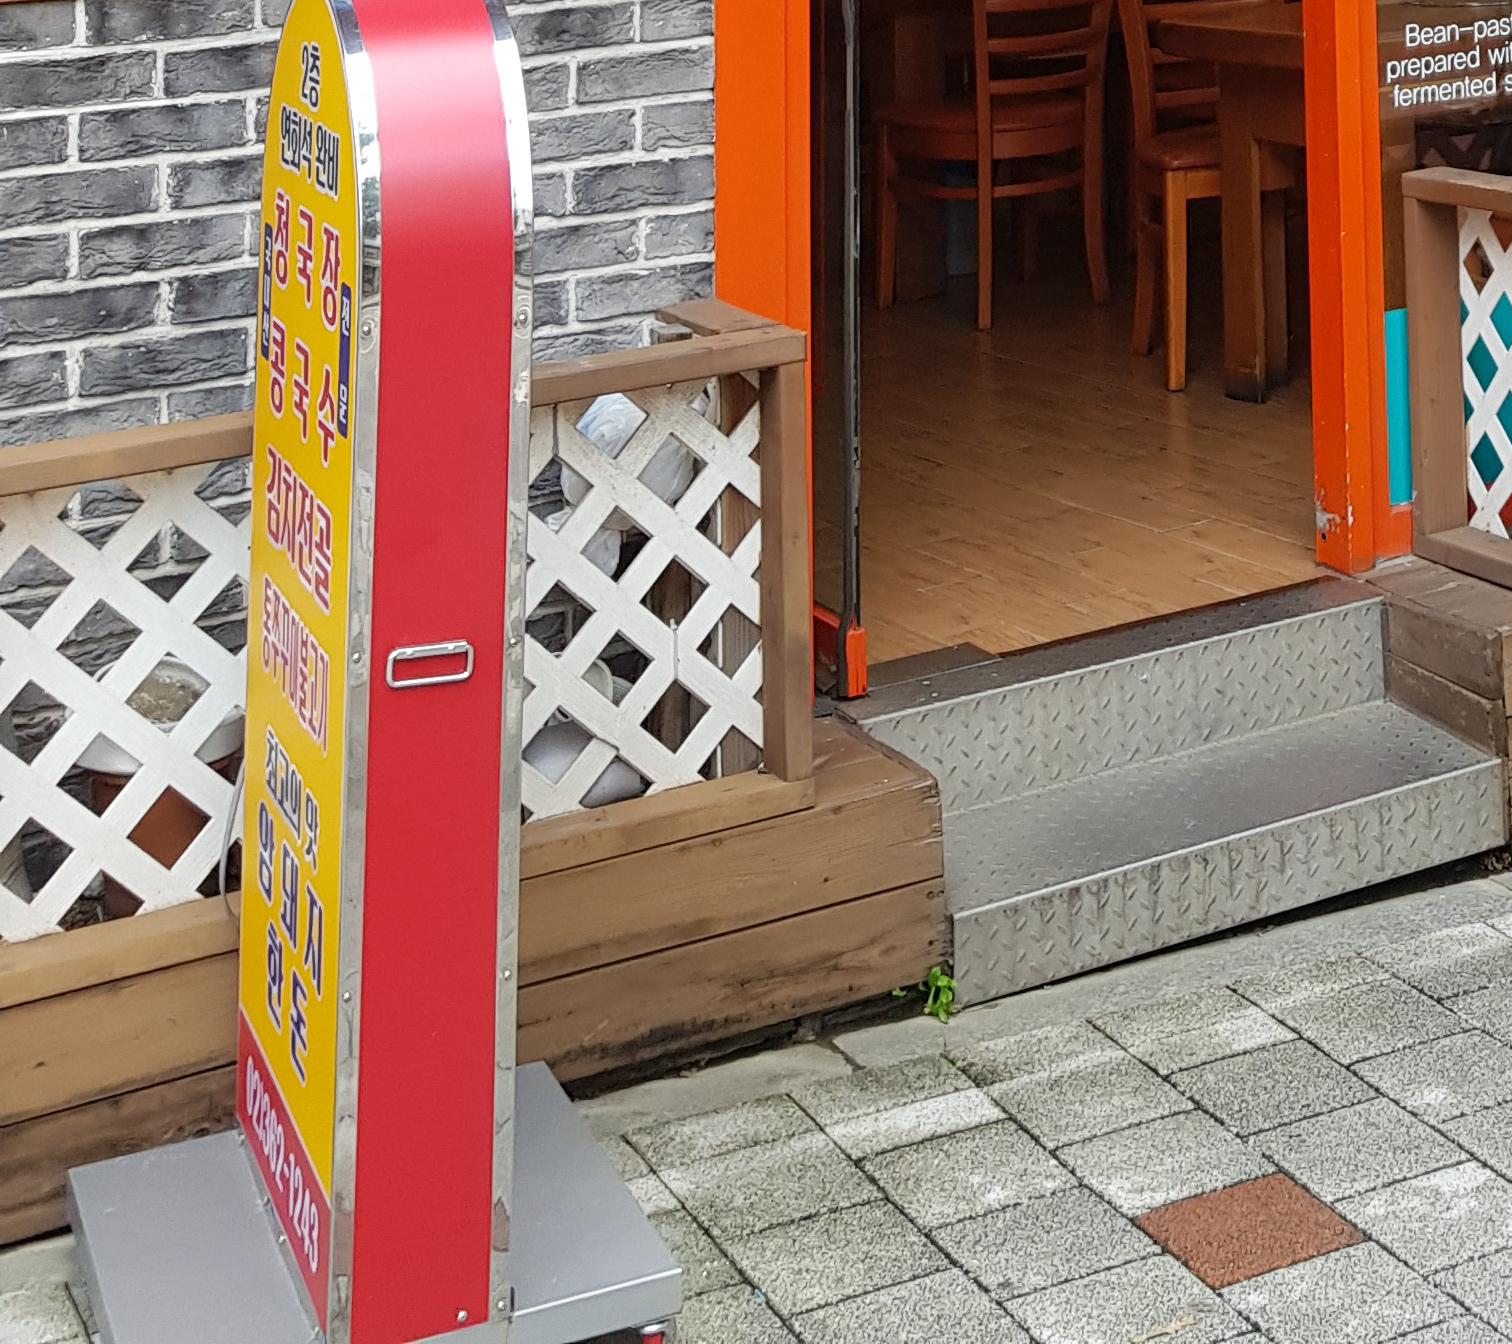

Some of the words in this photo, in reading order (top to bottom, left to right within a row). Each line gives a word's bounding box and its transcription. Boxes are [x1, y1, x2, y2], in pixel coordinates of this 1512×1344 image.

[300, 41, 321, 113] 2층
[1386, 46, 1480, 81] prepared
[1393, 72, 1497, 107] fermented
[280, 102, 314, 184] 연회석
[314, 118, 341, 204] 완비
[271, 187, 343, 333] 청국장
[269, 319, 336, 469] 콩국수
[265, 444, 333, 615] 김치전골
[266, 724, 302, 847] 최고의
[305, 787, 320, 877] 맛
[258, 799, 325, 1002] 암돼지
[266, 920, 308, 1088] 한돈
